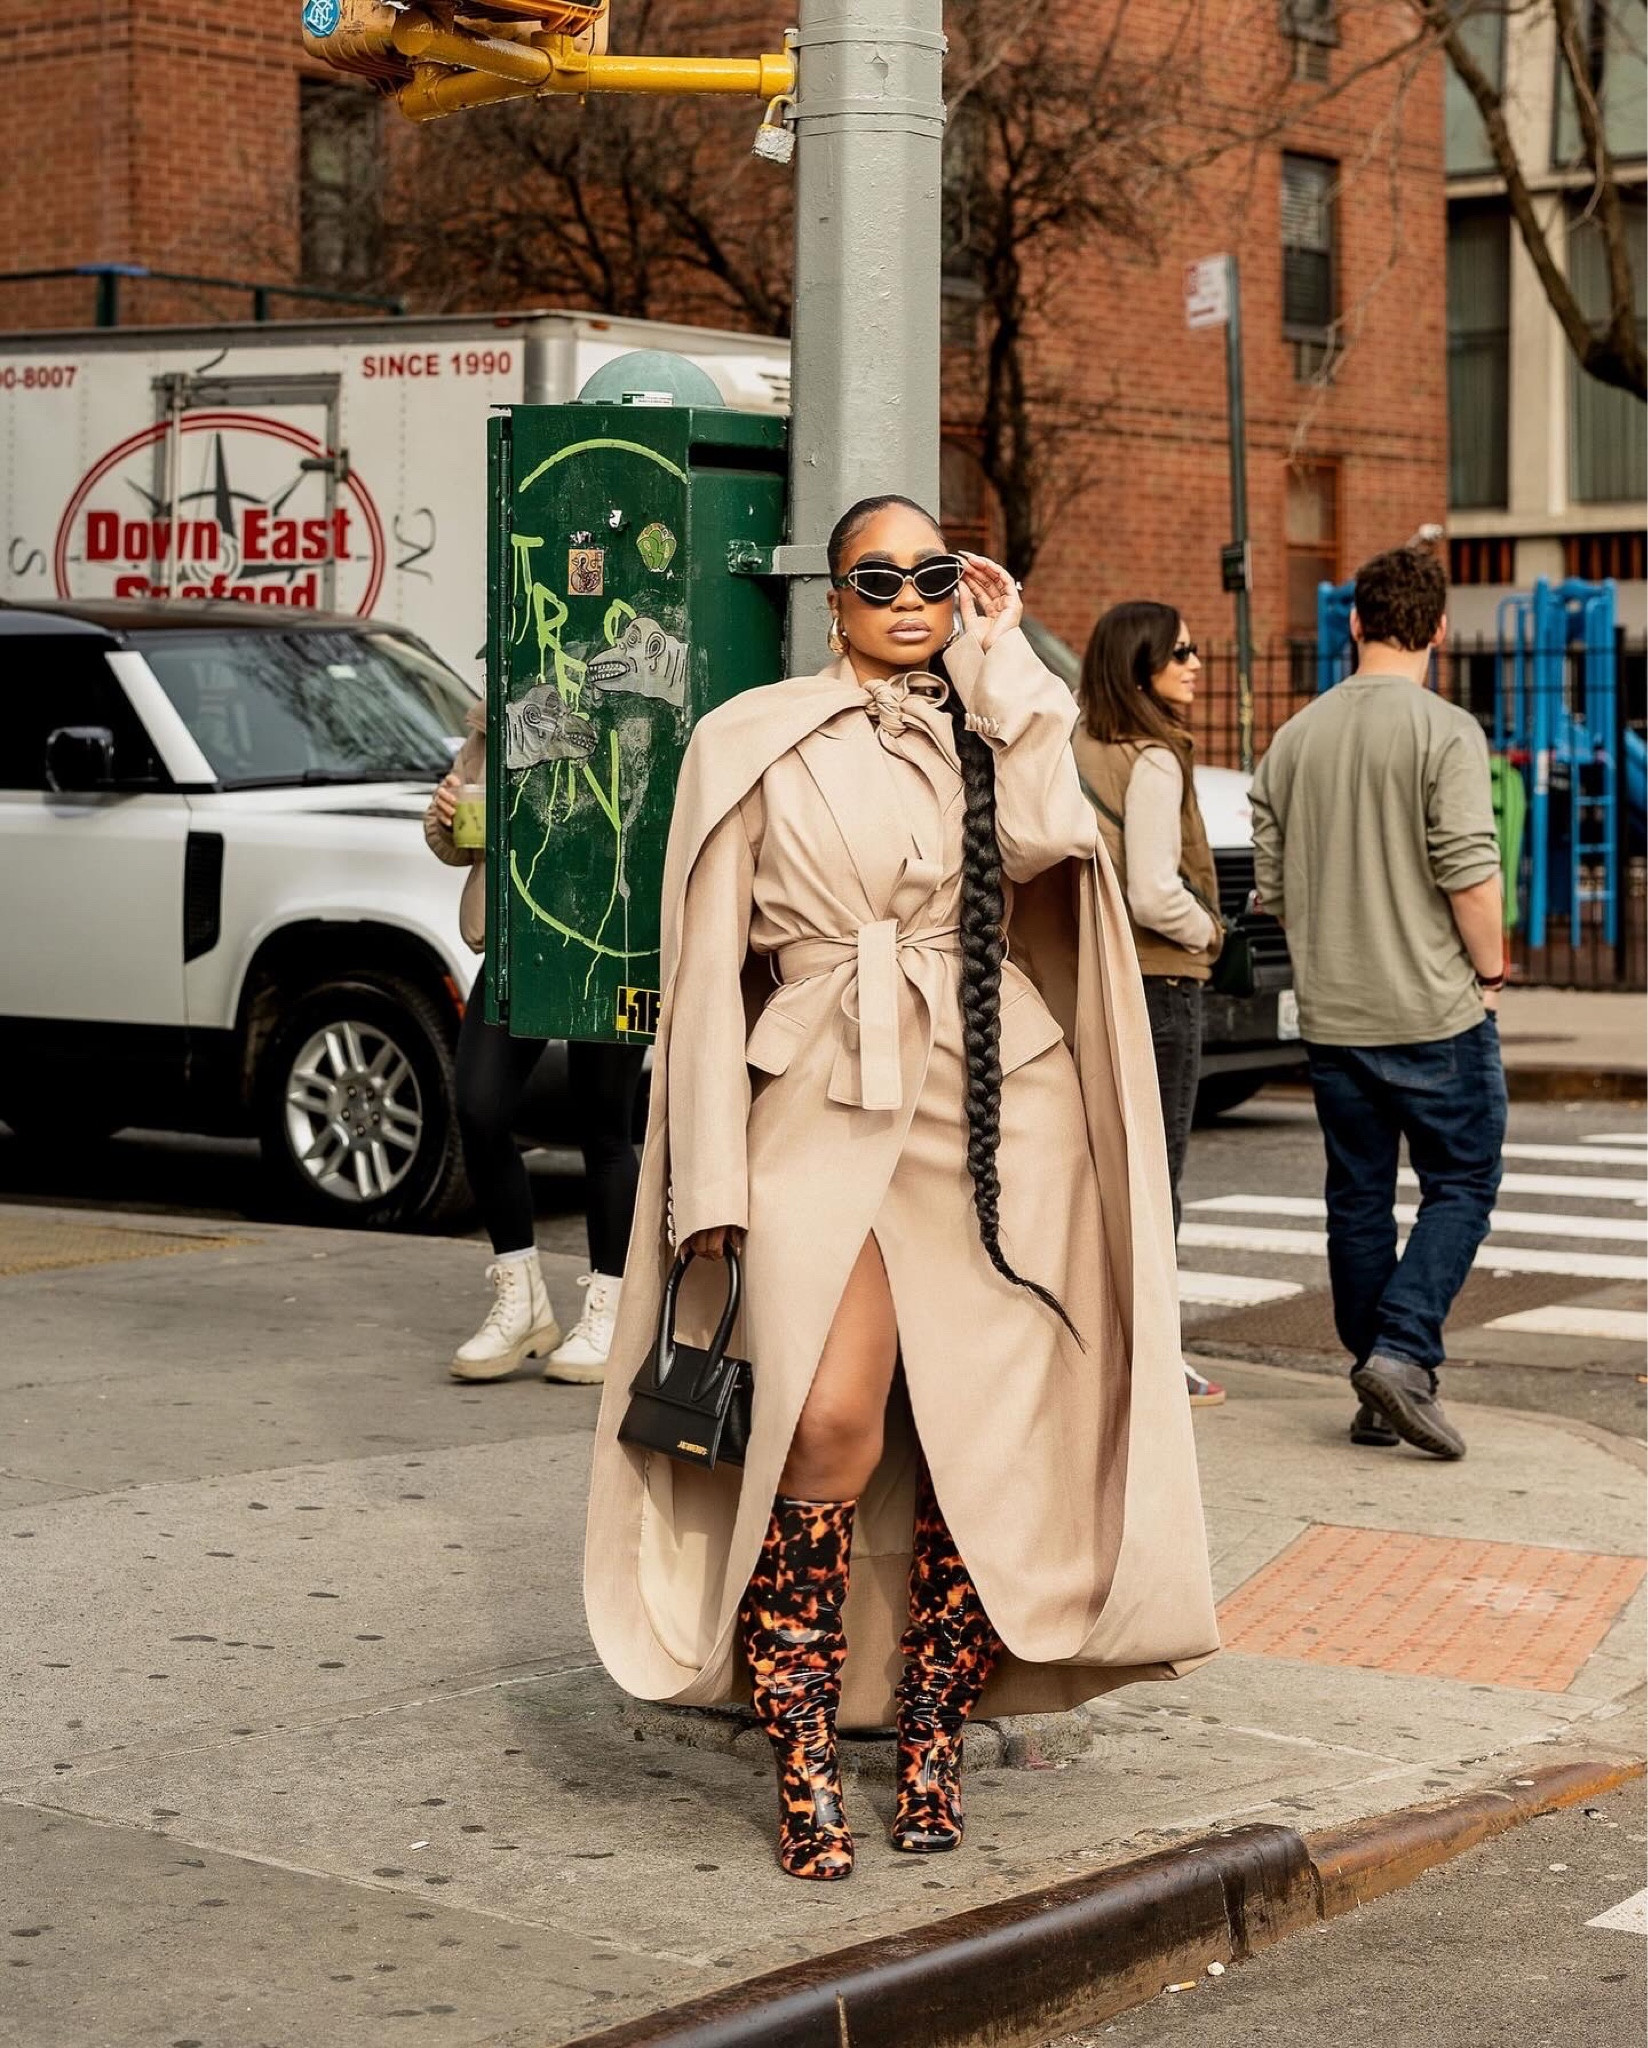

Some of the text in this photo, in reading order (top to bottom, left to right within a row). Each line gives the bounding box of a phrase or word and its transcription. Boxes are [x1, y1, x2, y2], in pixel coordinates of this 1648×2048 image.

[0, 367, 78, 389] 0-8007
[363, 352, 511, 378] SINCE 1990
[87, 508, 351, 561] Down East
